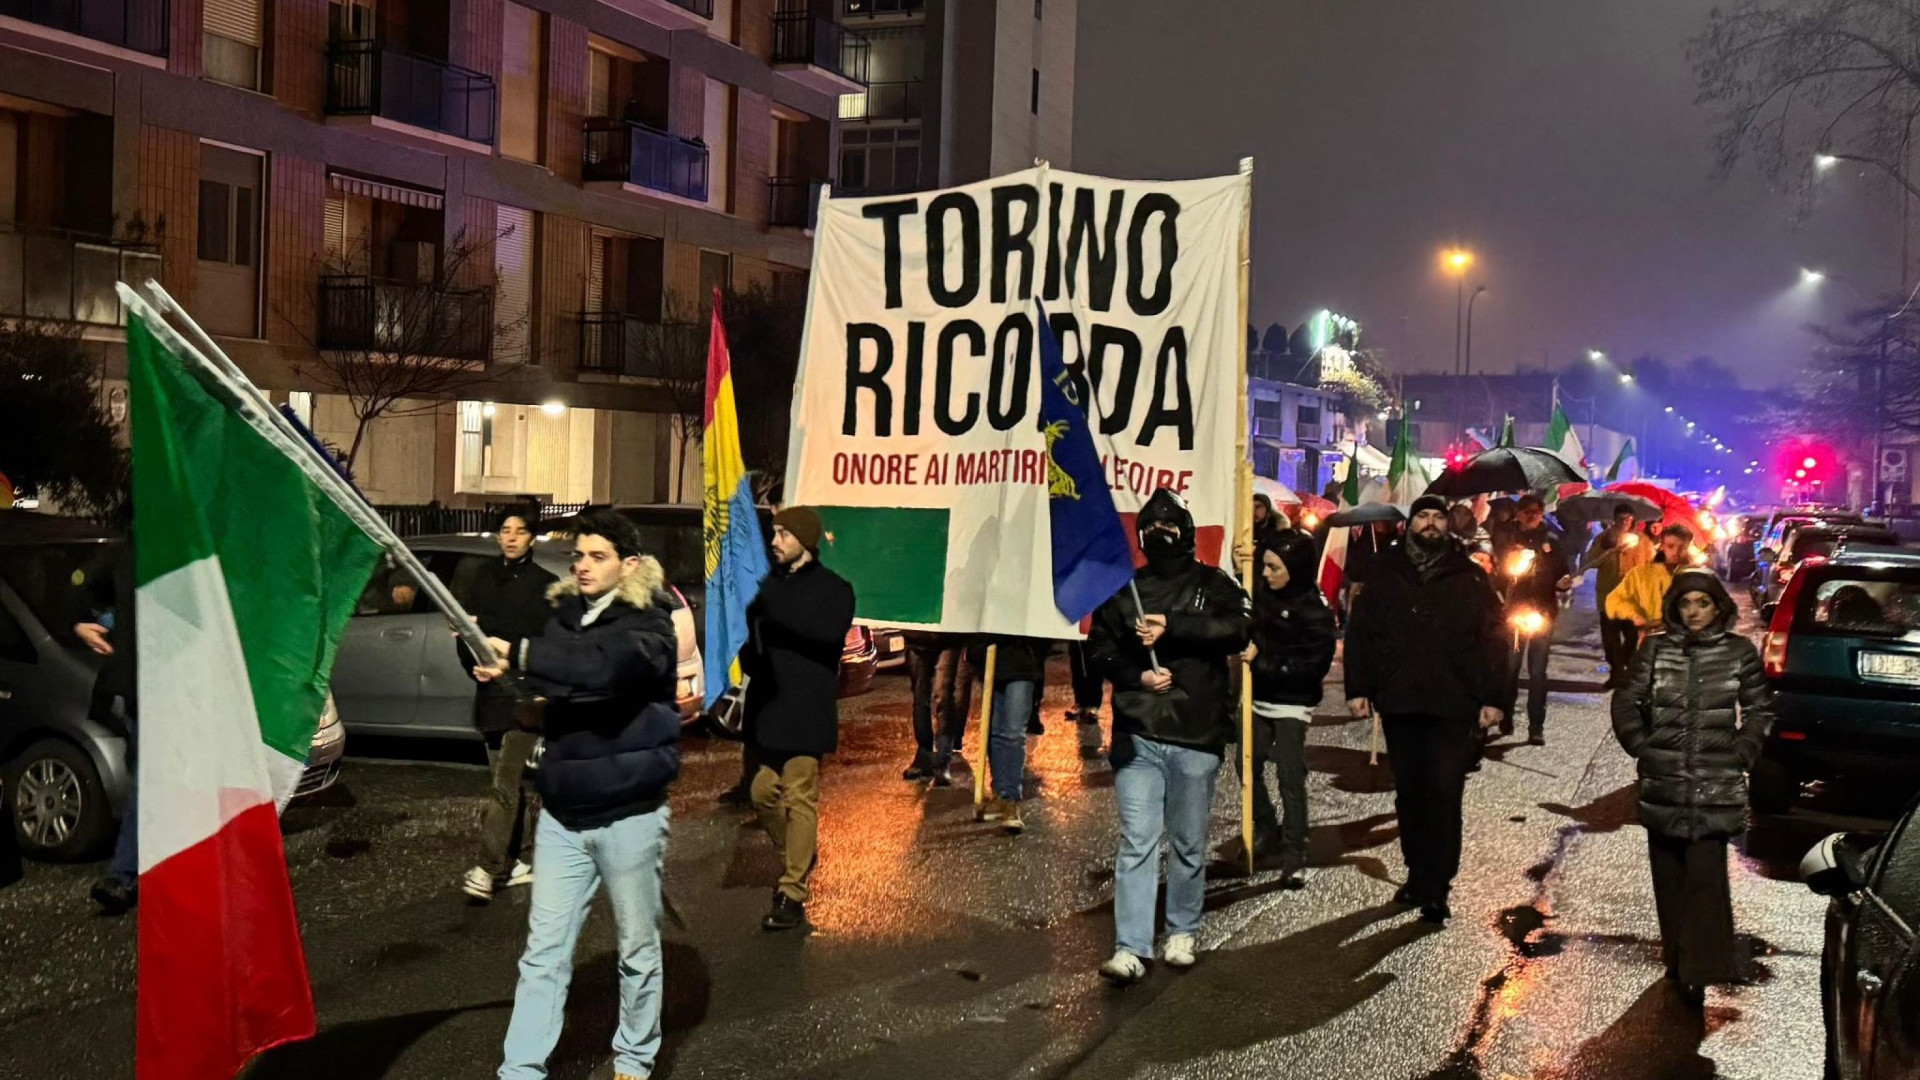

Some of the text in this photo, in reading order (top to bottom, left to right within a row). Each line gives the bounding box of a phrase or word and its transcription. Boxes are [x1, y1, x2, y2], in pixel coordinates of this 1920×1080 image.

[862, 182, 1180, 316] TORINO
[833, 453, 918, 485] ONORE
[924, 454, 949, 485] AI
[955, 449, 1046, 485] MARTIRI
